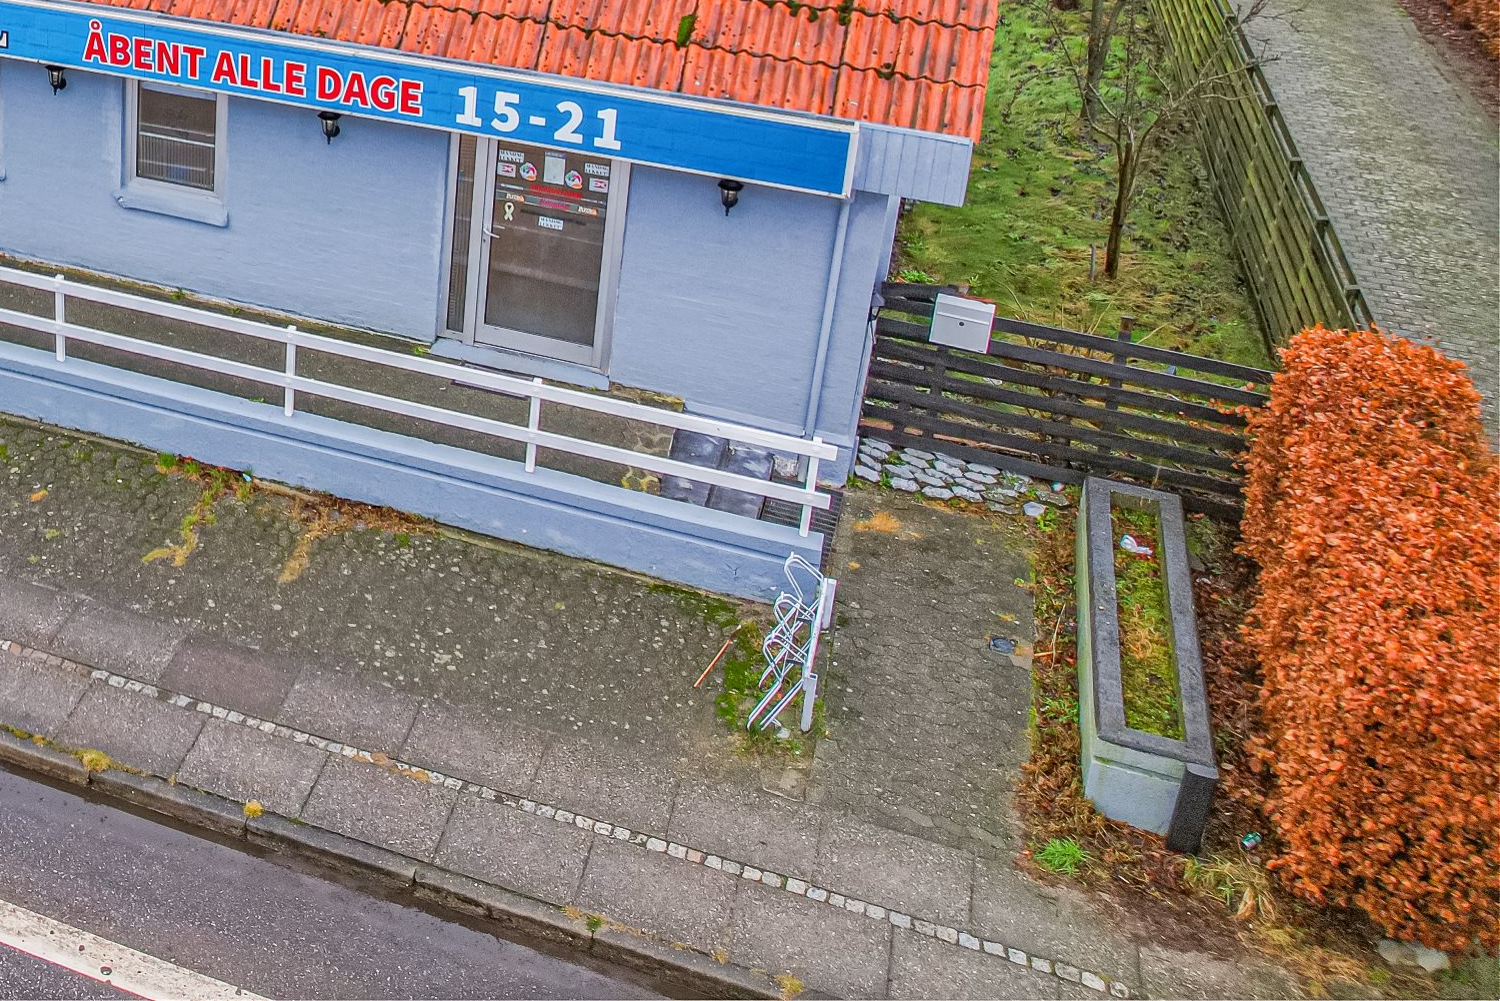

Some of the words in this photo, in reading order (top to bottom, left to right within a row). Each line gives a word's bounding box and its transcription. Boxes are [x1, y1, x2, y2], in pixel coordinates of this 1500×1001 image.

[82, 18, 206, 80] ÅBENT
[211, 50, 307, 97] ALLE
[315, 66, 424, 116] DAGE
[456, 86, 622, 150] 15-21
